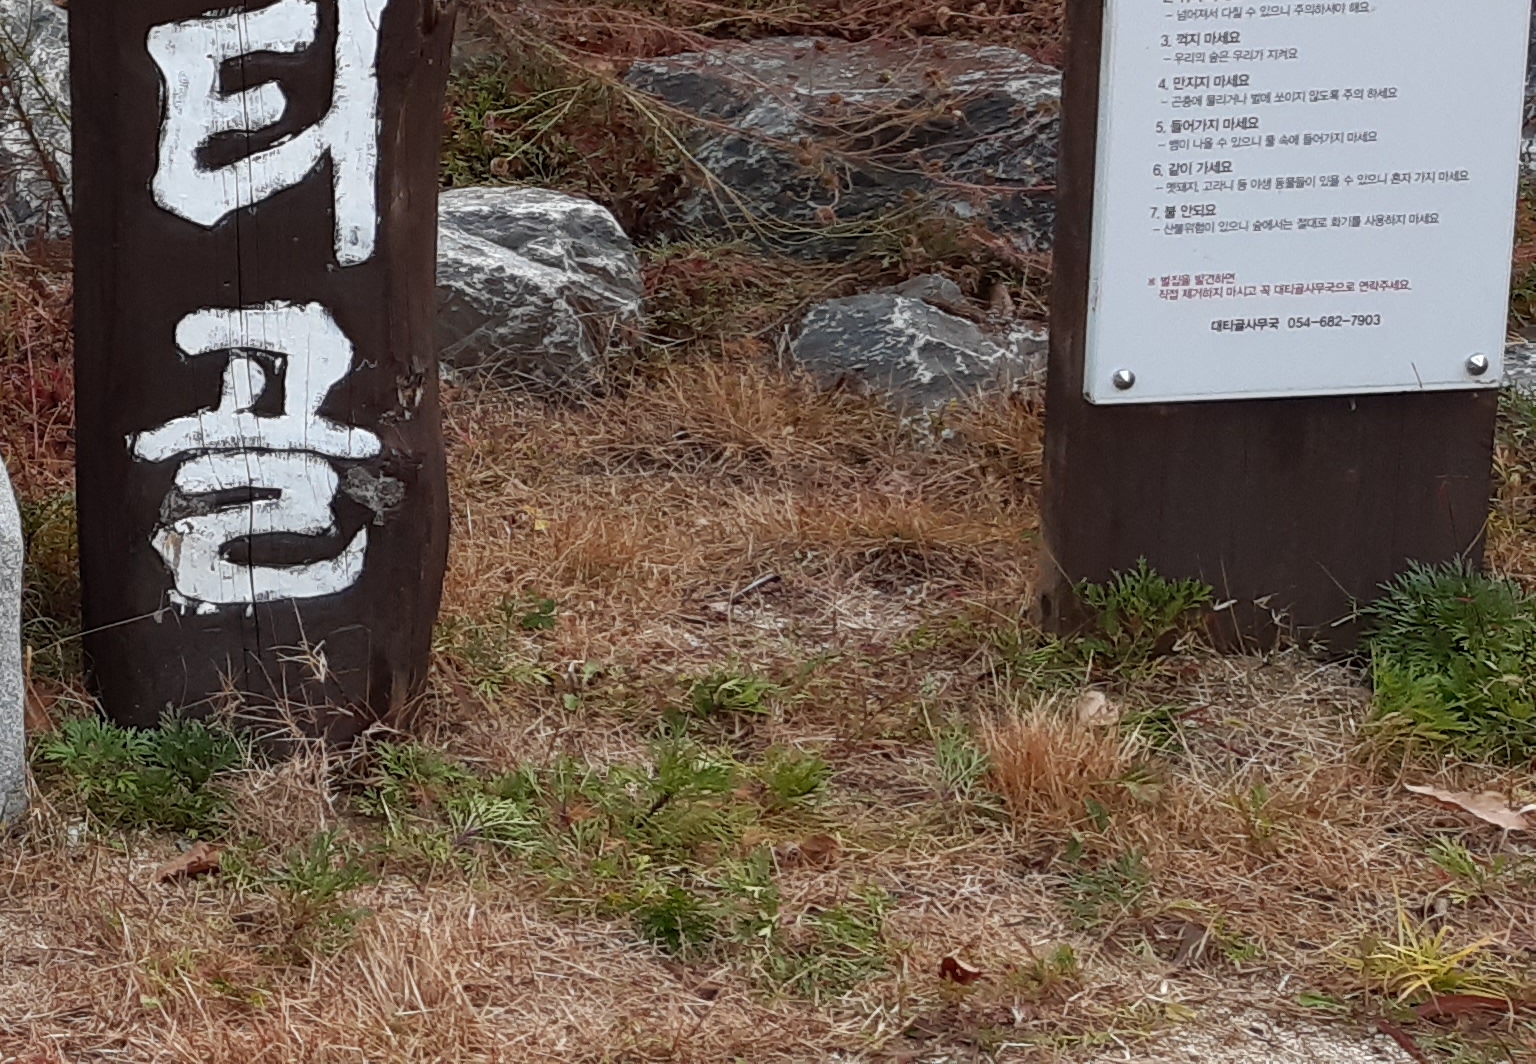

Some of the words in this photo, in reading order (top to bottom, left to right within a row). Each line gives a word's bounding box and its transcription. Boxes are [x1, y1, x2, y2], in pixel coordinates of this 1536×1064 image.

[1161, 34, 1172, 48] 3.
[1204, 30, 1240, 46] 마세요
[1158, 78, 1169, 91] 4.
[1173, 76, 1210, 90] 만지지
[1213, 73, 1250, 89] 마세요
[1156, 121, 1166, 134] 5.
[1170, 117, 1219, 133] 들어가지
[1223, 116, 1259, 131] 마세요
[1153, 164, 1163, 177] 6.
[1169, 162, 1192, 177] 같이
[1197, 160, 1233, 175] 가세요
[1150, 207, 1160, 219] 7.
[1165, 205, 1176, 220] 불
[1287, 313, 1381, 329] 054-682-7903
